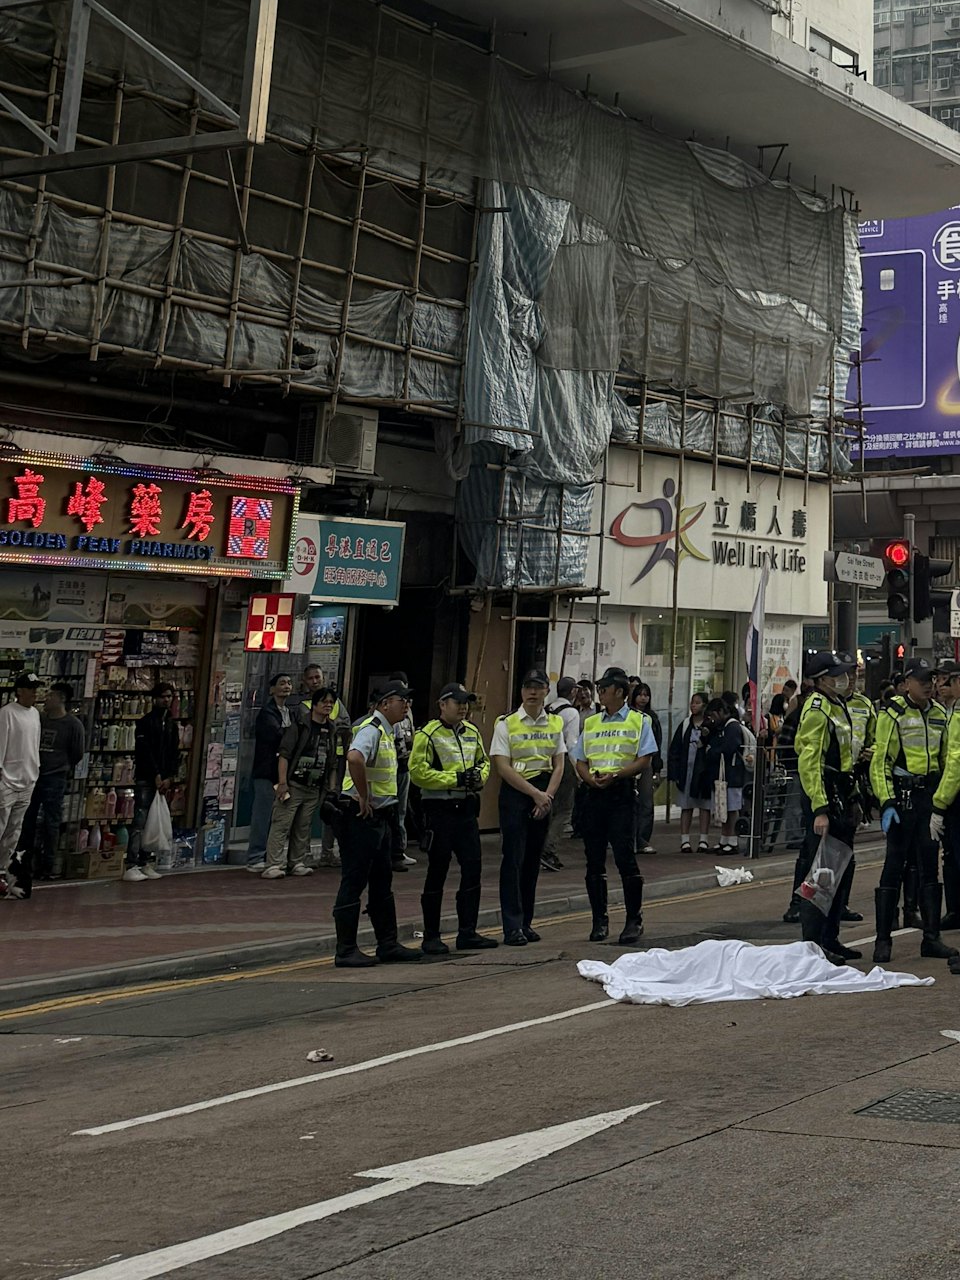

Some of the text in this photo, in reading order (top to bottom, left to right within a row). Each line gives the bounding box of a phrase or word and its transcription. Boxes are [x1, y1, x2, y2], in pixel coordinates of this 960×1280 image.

[938, 302, 949, 325] 高達
[8, 468, 216, 541] 高峰藥房
[0, 530, 67, 550] GOLDEN
[130, 540, 215, 561] PHARMACY
[712, 540, 807, 573] Well Link Life
[323, 566, 388, 588] 旺角服務中心
